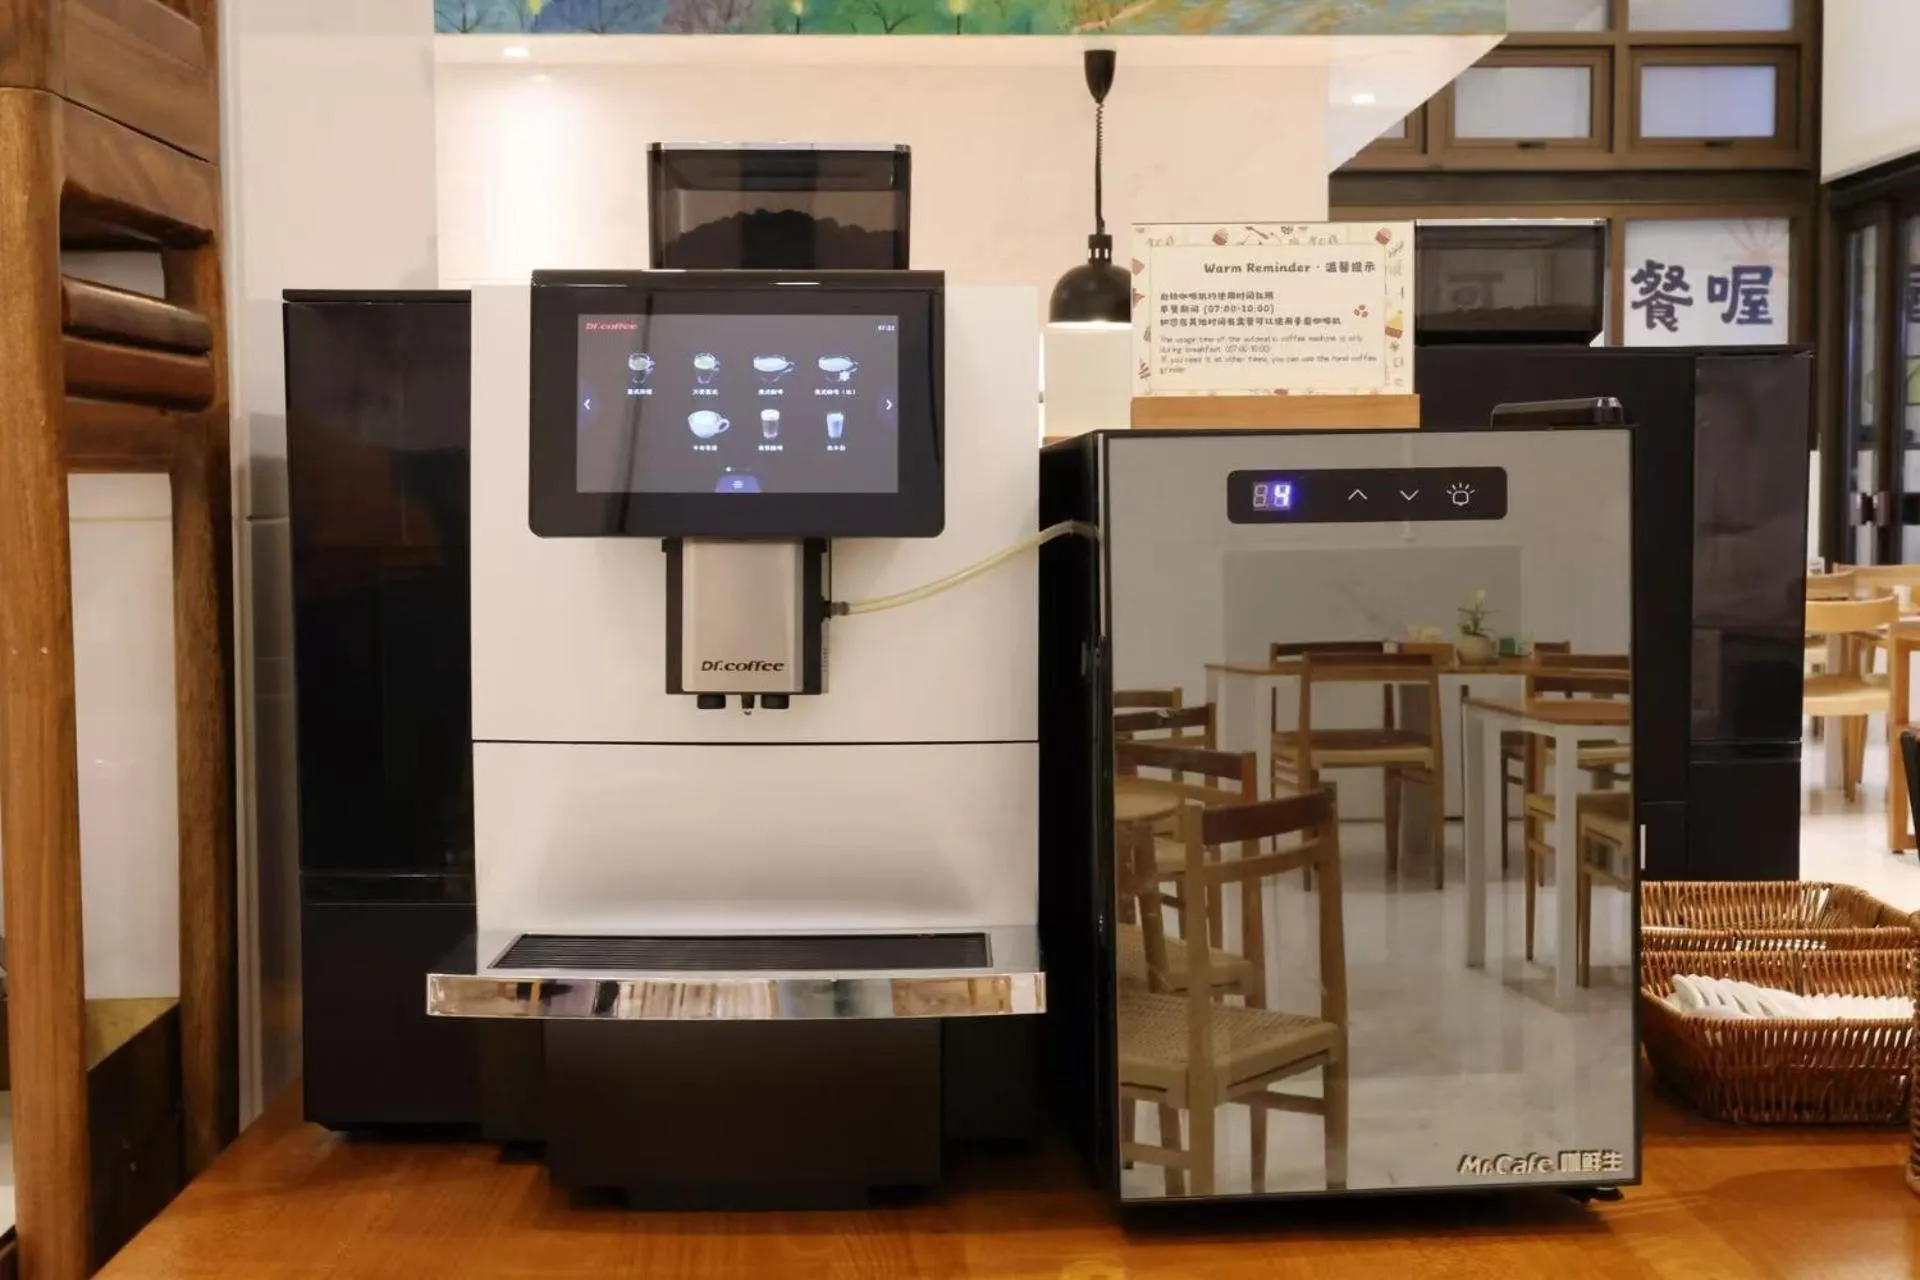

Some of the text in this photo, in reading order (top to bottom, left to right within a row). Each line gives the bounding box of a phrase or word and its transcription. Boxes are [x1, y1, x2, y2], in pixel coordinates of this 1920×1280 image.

[1204, 263, 1242, 274] Warm
[1247, 262, 1311, 273] Reminder
[701, 660, 784, 671] Dr.coffee
